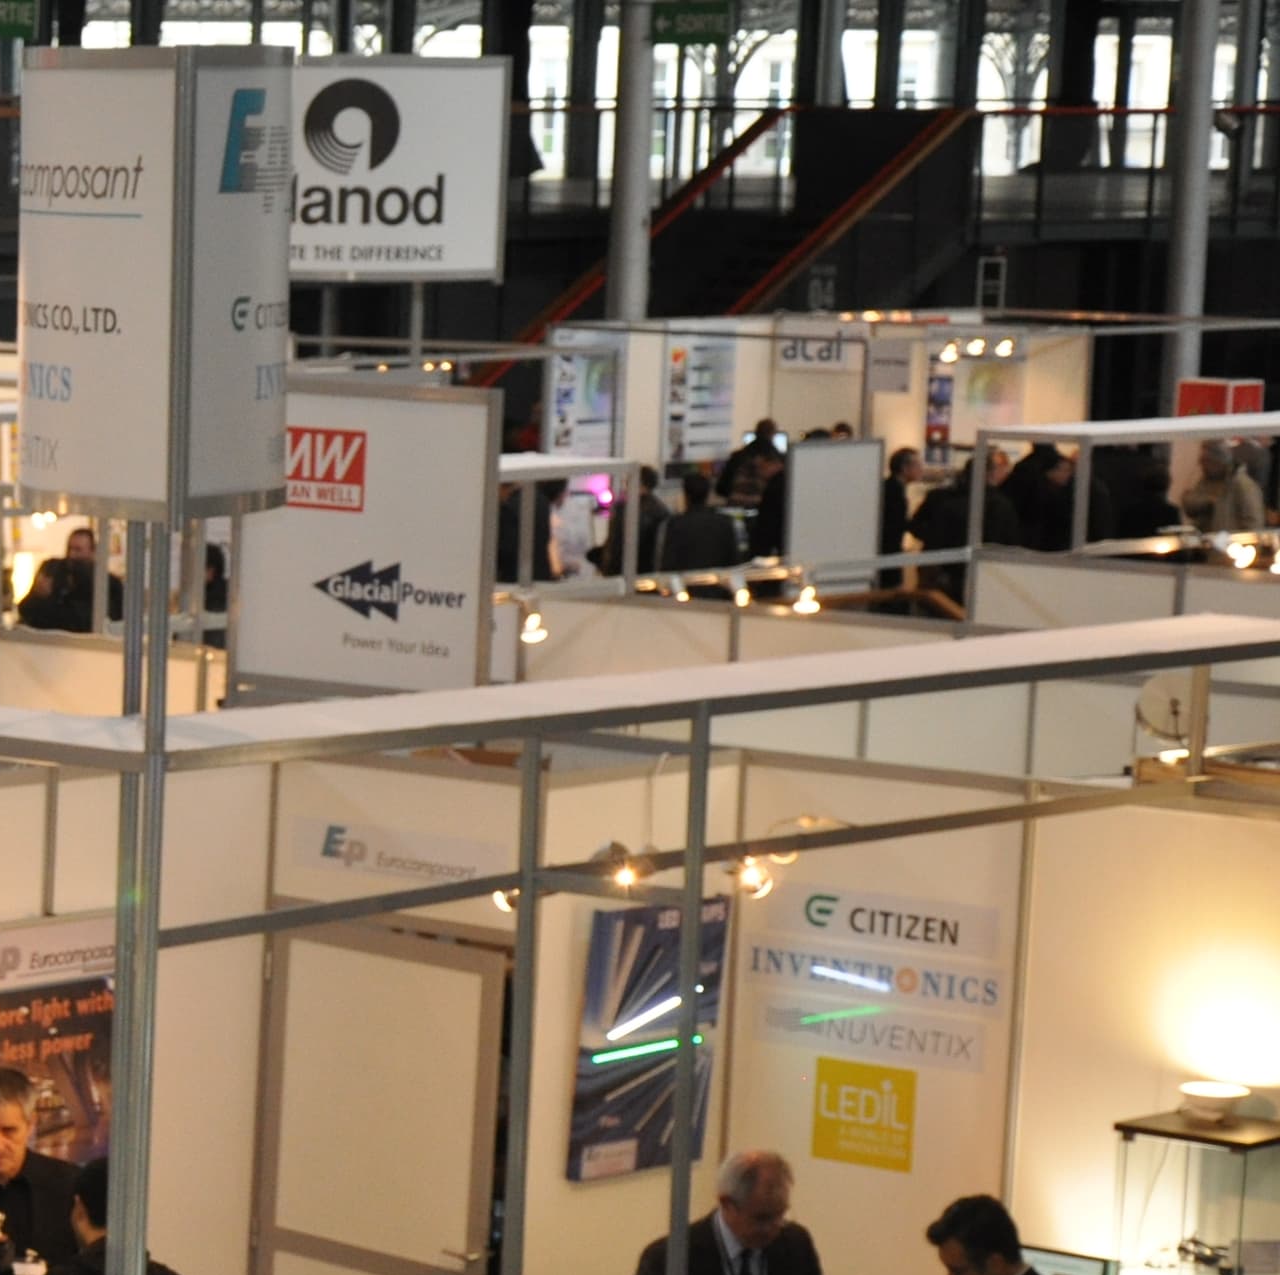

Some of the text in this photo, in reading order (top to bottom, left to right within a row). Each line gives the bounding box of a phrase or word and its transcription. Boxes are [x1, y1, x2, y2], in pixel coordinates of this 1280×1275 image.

[313, 246, 343, 260] THE
[349, 245, 445, 262] DIFFERENCE
[317, 486, 355, 505] WELL
[342, 633, 450, 659] Power Your Idea
[849, 906, 959, 946] CITIZEN
[31, 999, 71, 1026] light
[75, 993, 114, 1020] with
[40, 1033, 94, 1063] power
[823, 1015, 974, 1061] NUVENTIX
